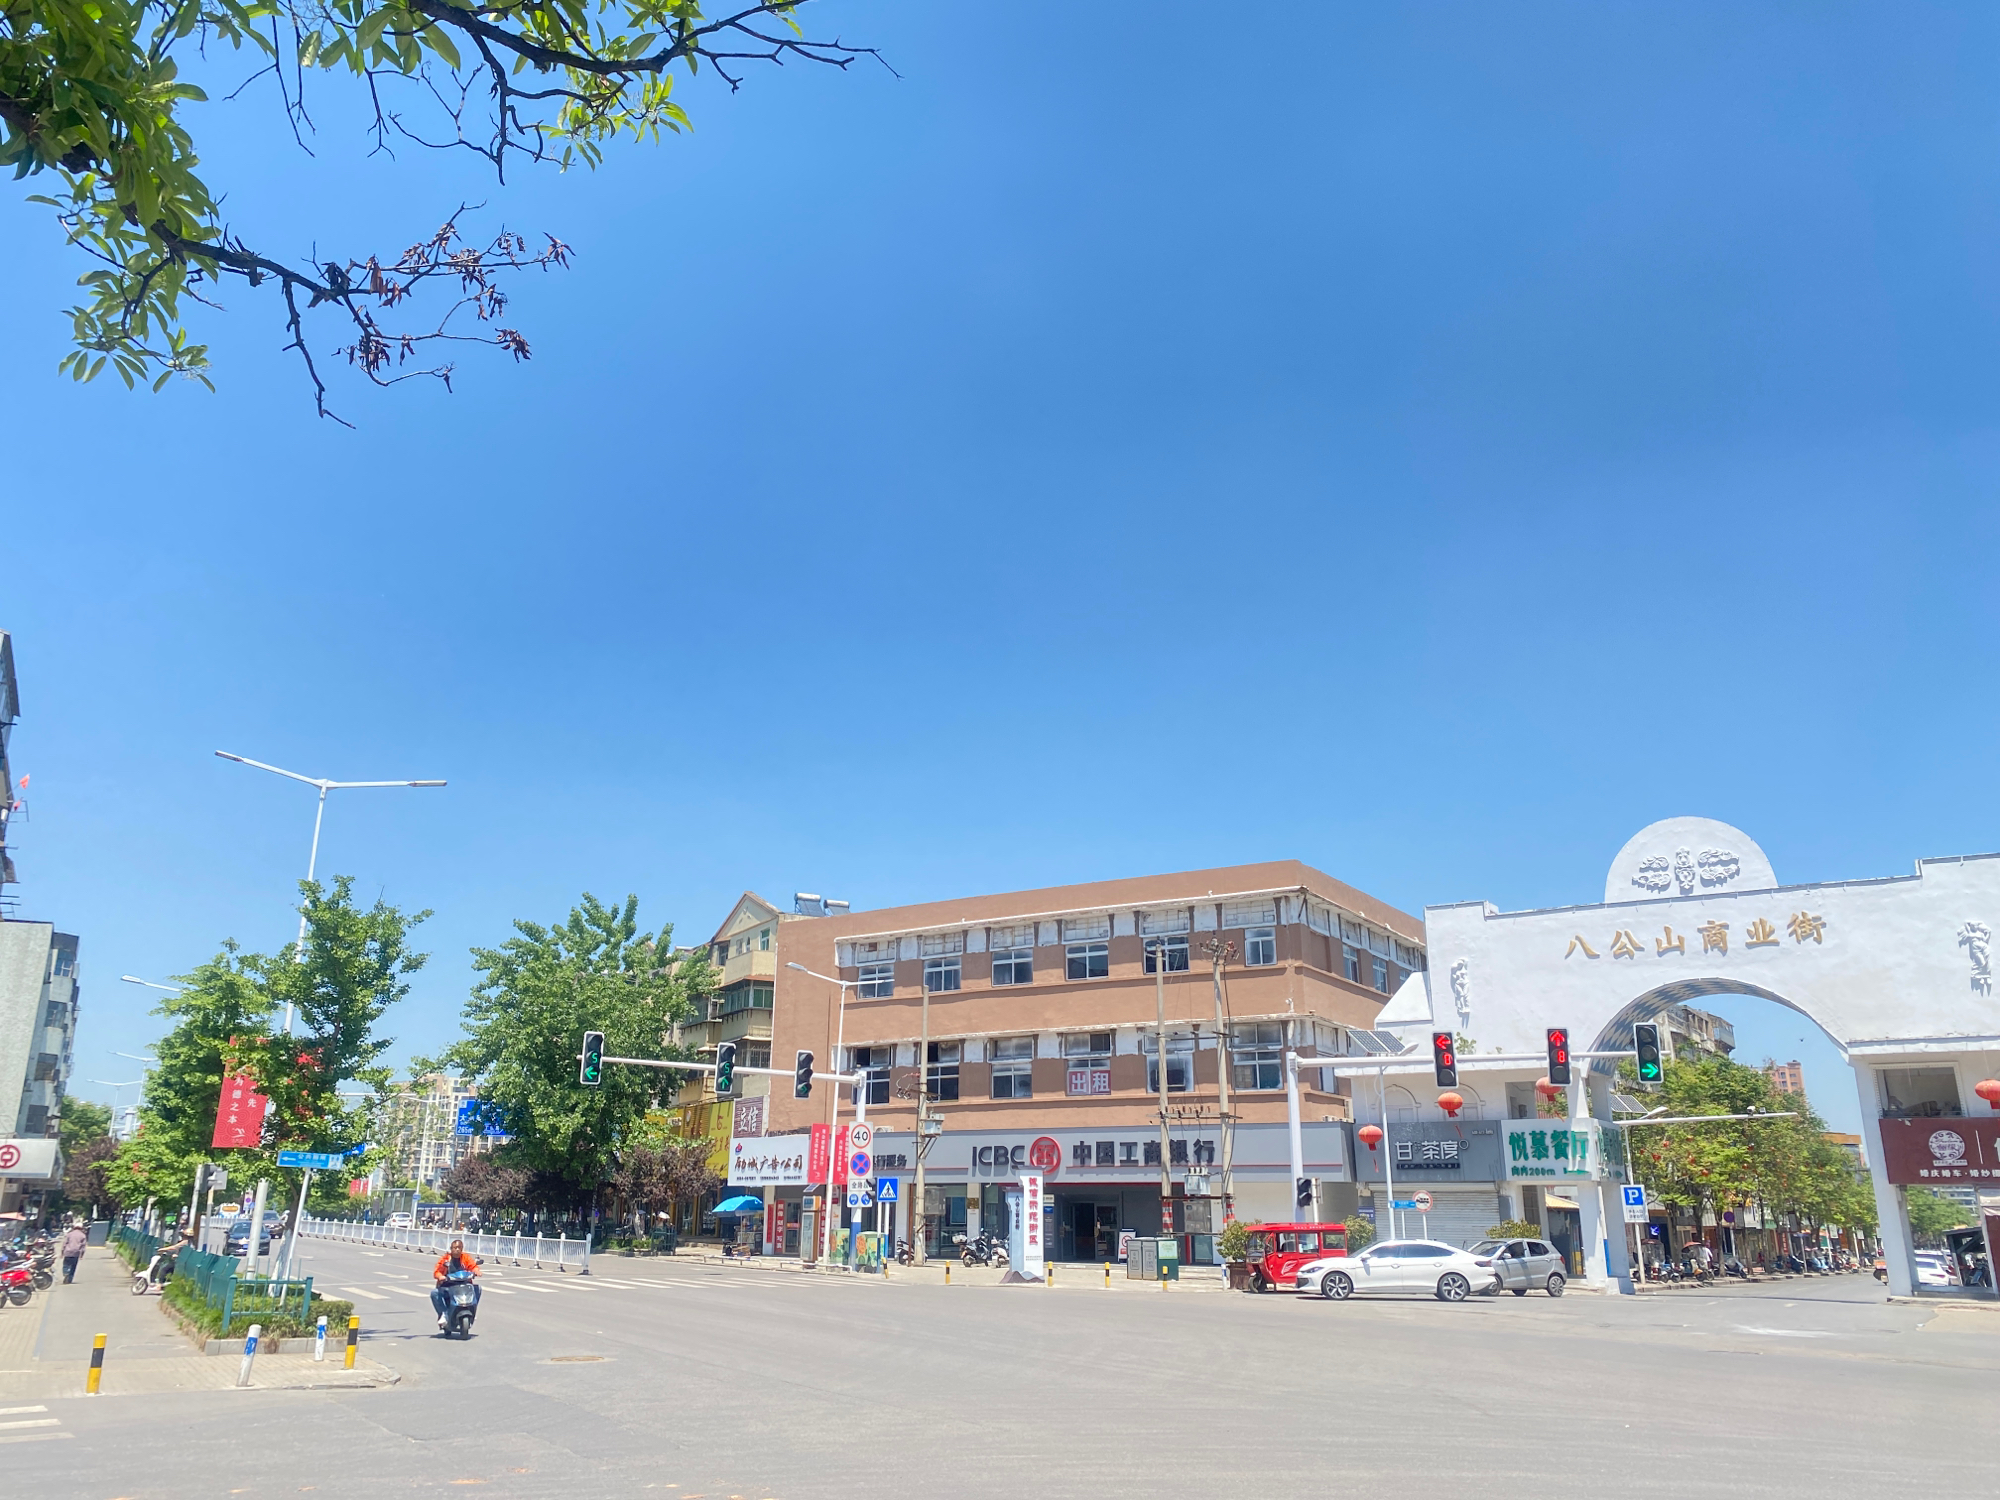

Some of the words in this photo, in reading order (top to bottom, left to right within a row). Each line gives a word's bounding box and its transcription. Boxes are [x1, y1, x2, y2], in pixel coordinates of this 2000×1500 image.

[1564, 911, 1827, 960] 八公山商业街
[1071, 1072, 1110, 1092] 出租
[738, 1106, 759, 1132] 立信
[854, 1131, 868, 1141] 40
[1508, 1129, 1589, 1161] 悦慕餐厅
[972, 1145, 1026, 1168] ICBC
[1072, 1138, 1216, 1168] 中国工商银行
[1627, 1189, 1640, 1204] P
